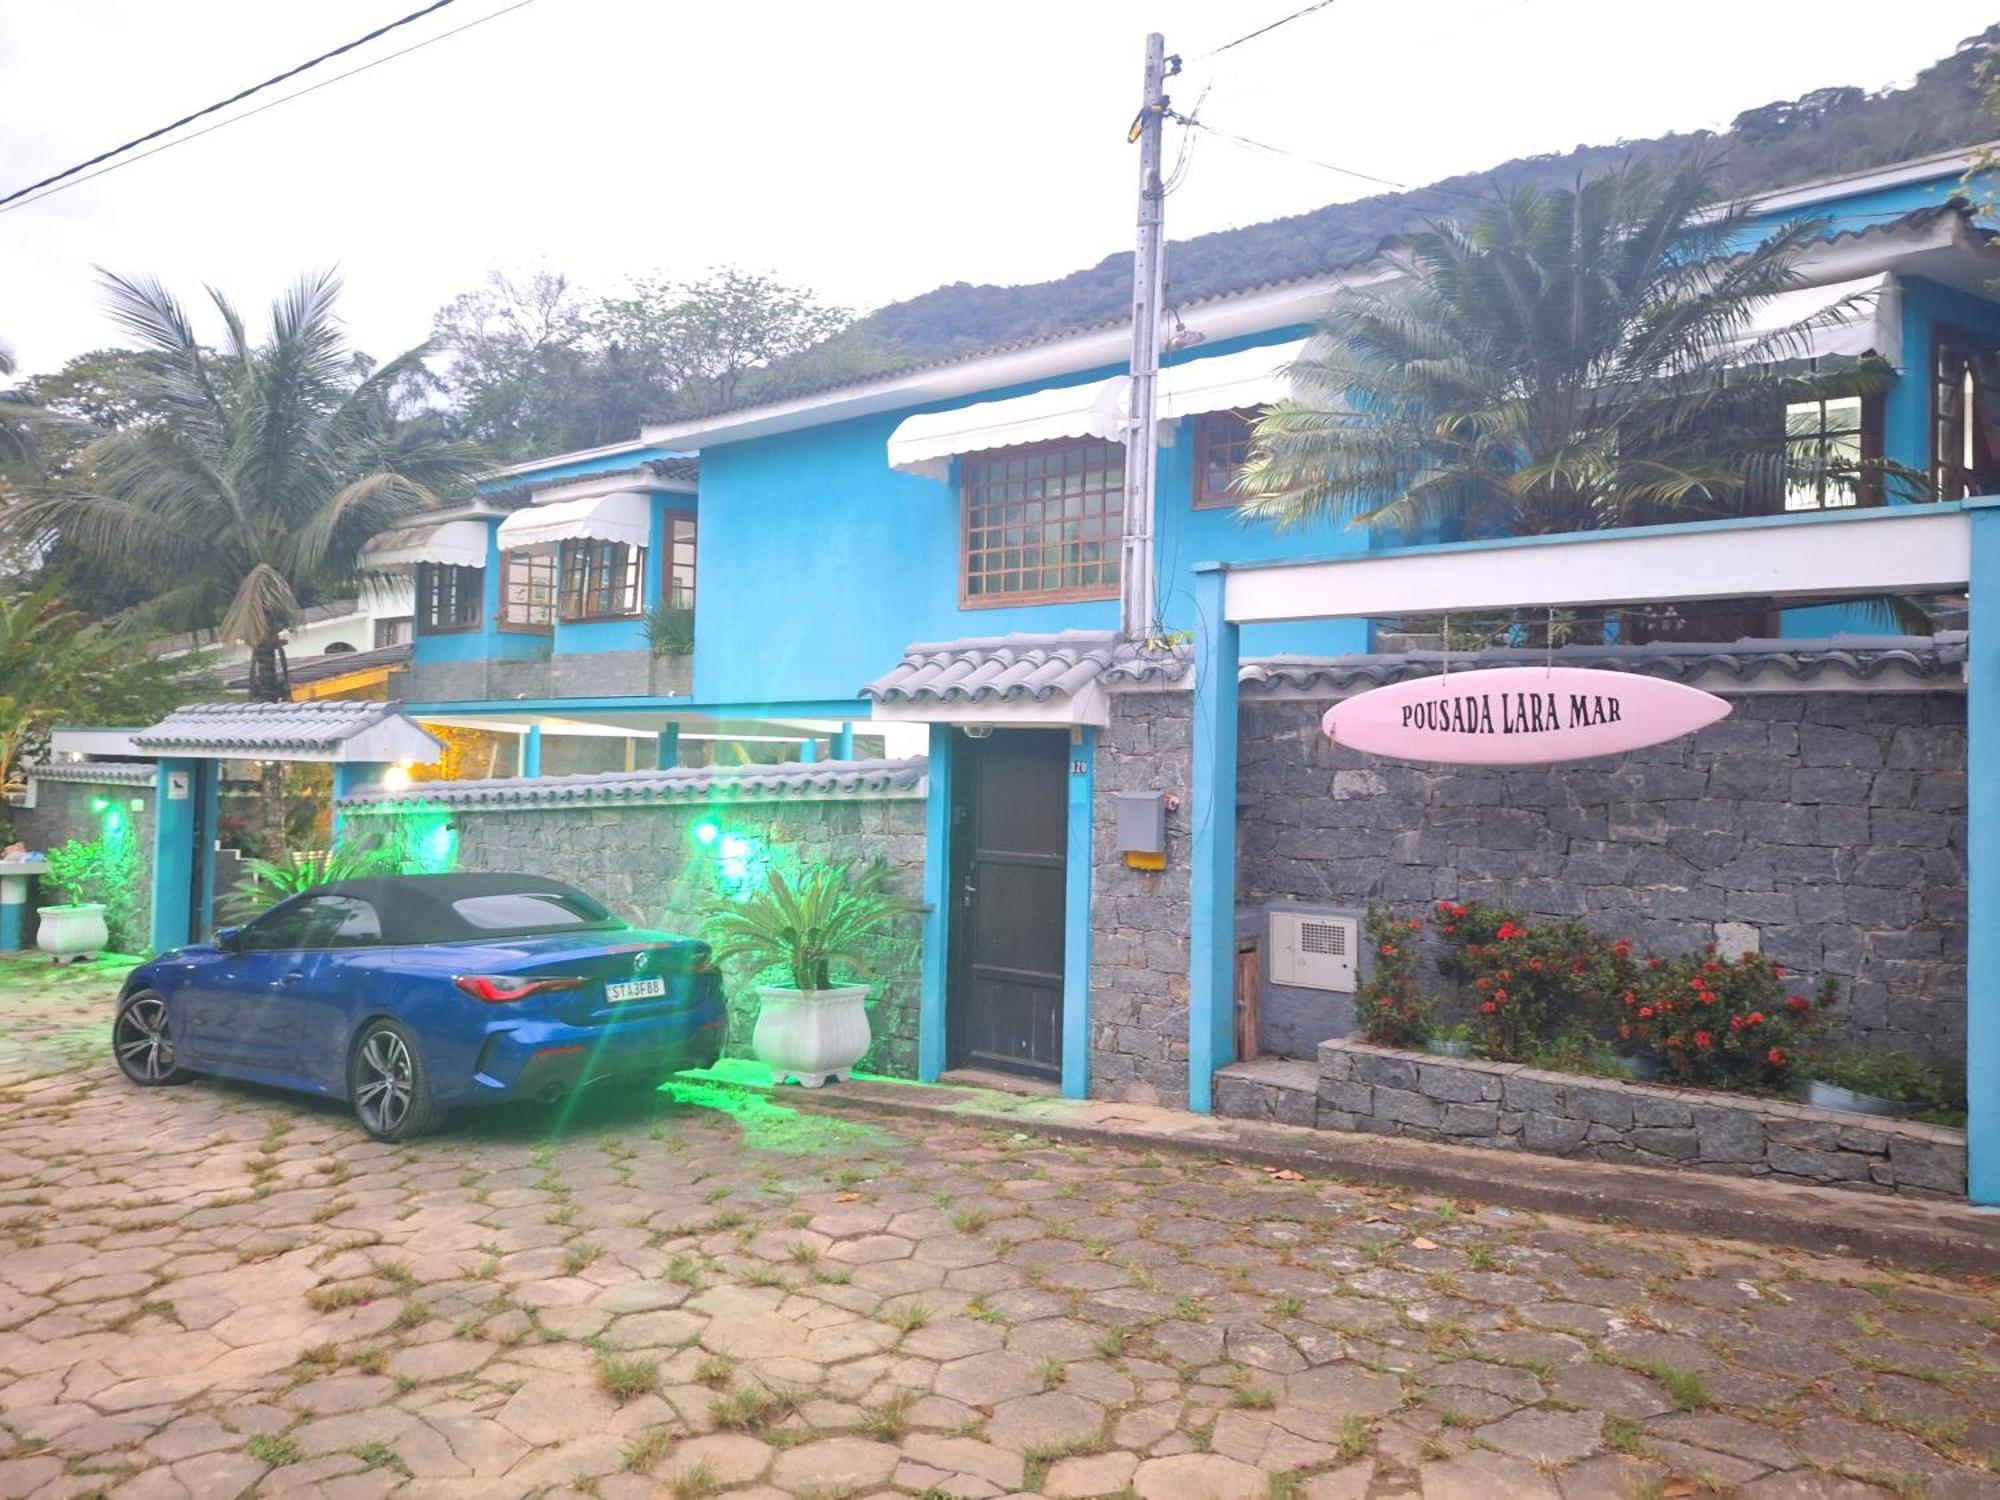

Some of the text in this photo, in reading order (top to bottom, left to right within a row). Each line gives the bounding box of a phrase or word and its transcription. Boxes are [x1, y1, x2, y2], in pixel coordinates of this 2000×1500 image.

[1402, 693, 1621, 733] POUSADA LARA MAR
